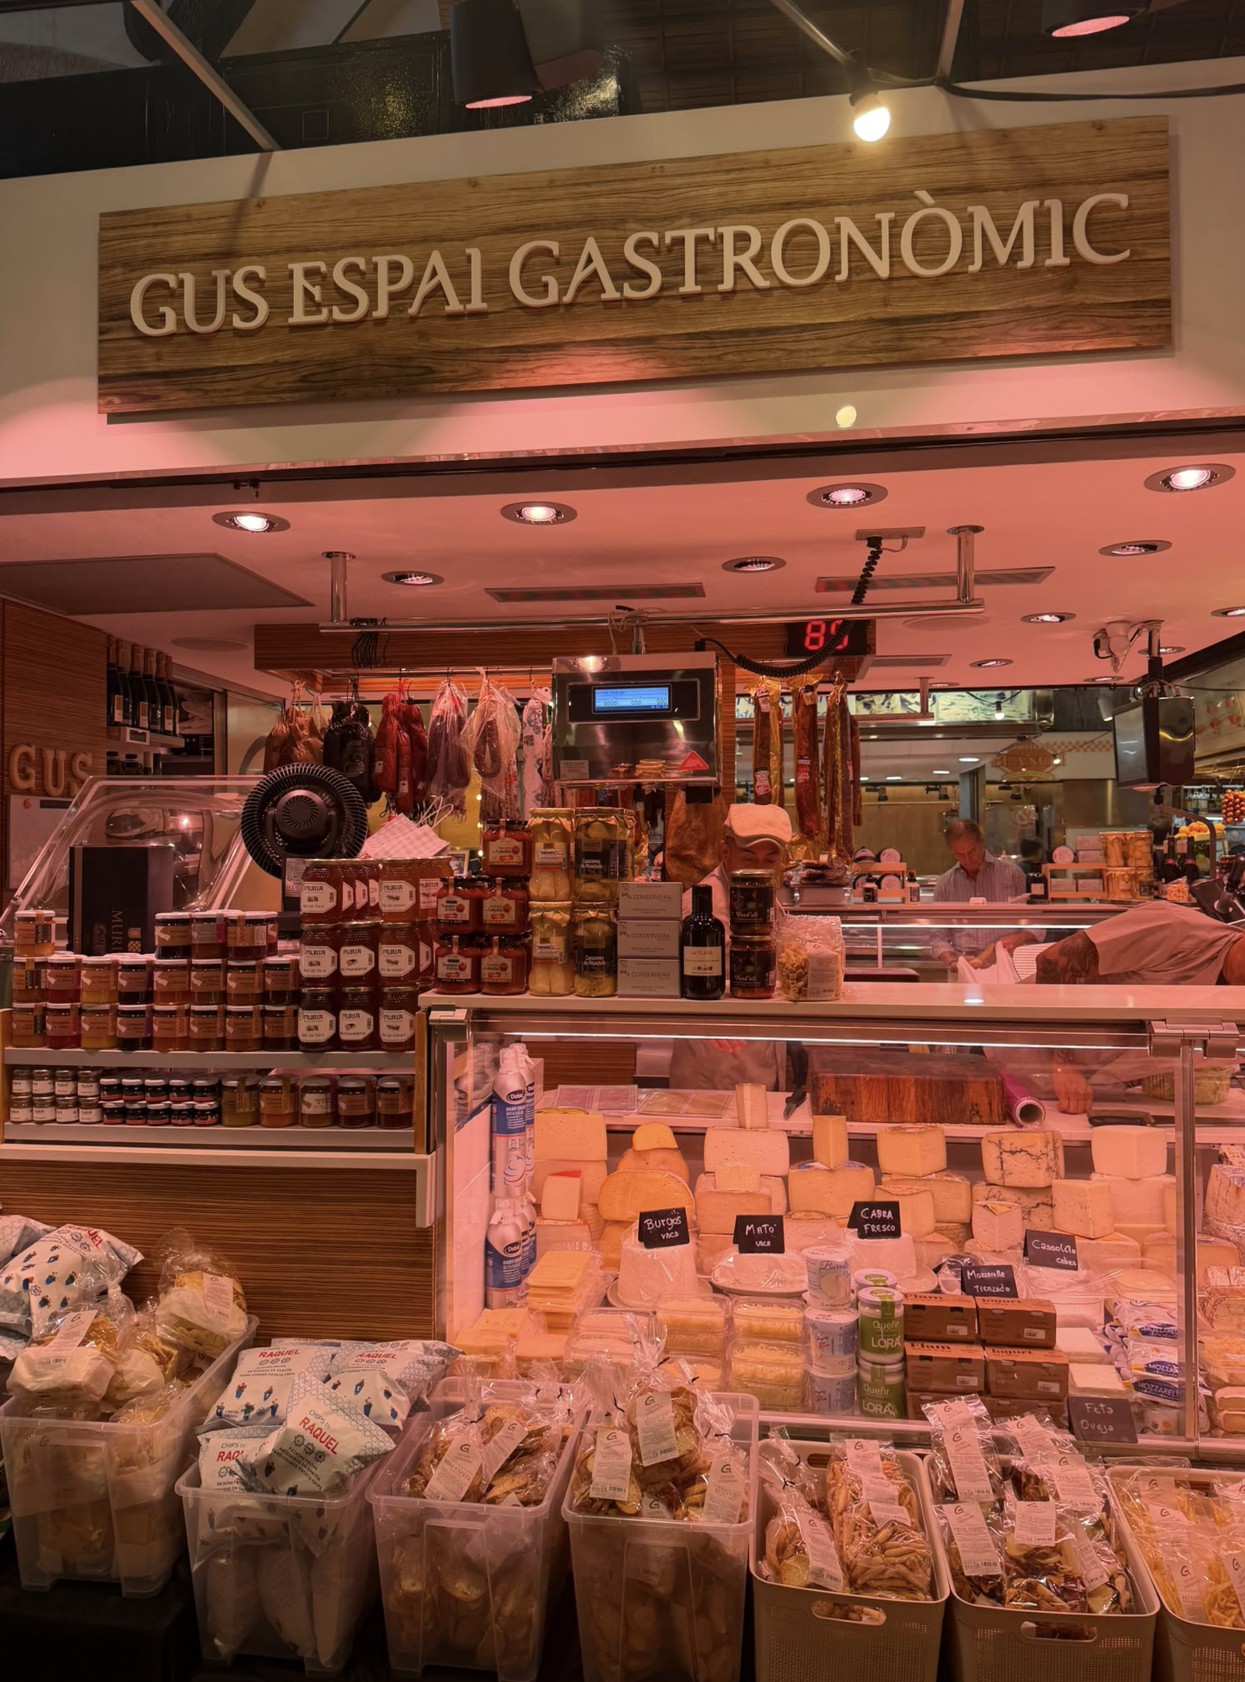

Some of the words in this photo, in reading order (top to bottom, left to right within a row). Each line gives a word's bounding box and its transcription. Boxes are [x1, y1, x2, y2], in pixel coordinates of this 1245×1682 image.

[129, 264, 268, 337] GUS
[287, 247, 487, 328] ESPAI
[508, 190, 1131, 308] GASTRONÒMIC
[9, 743, 93, 797] GUS
[860, 1207, 893, 1220] CABRA
[643, 1216, 682, 1231] Burgos
[863, 1223, 896, 1235] FRESCO
[873, 1320, 899, 1330] Quefir
[258, 1349, 300, 1358] RAQUEL
[863, 1383, 890, 1395] Quefir
[1084, 1402, 1114, 1414] Feta
[308, 1409, 327, 1425] CHIPS
[1080, 1419, 1114, 1434] Oveja
[299, 1416, 340, 1456] RAQUEL
[216, 1450, 244, 1463] RAQ
